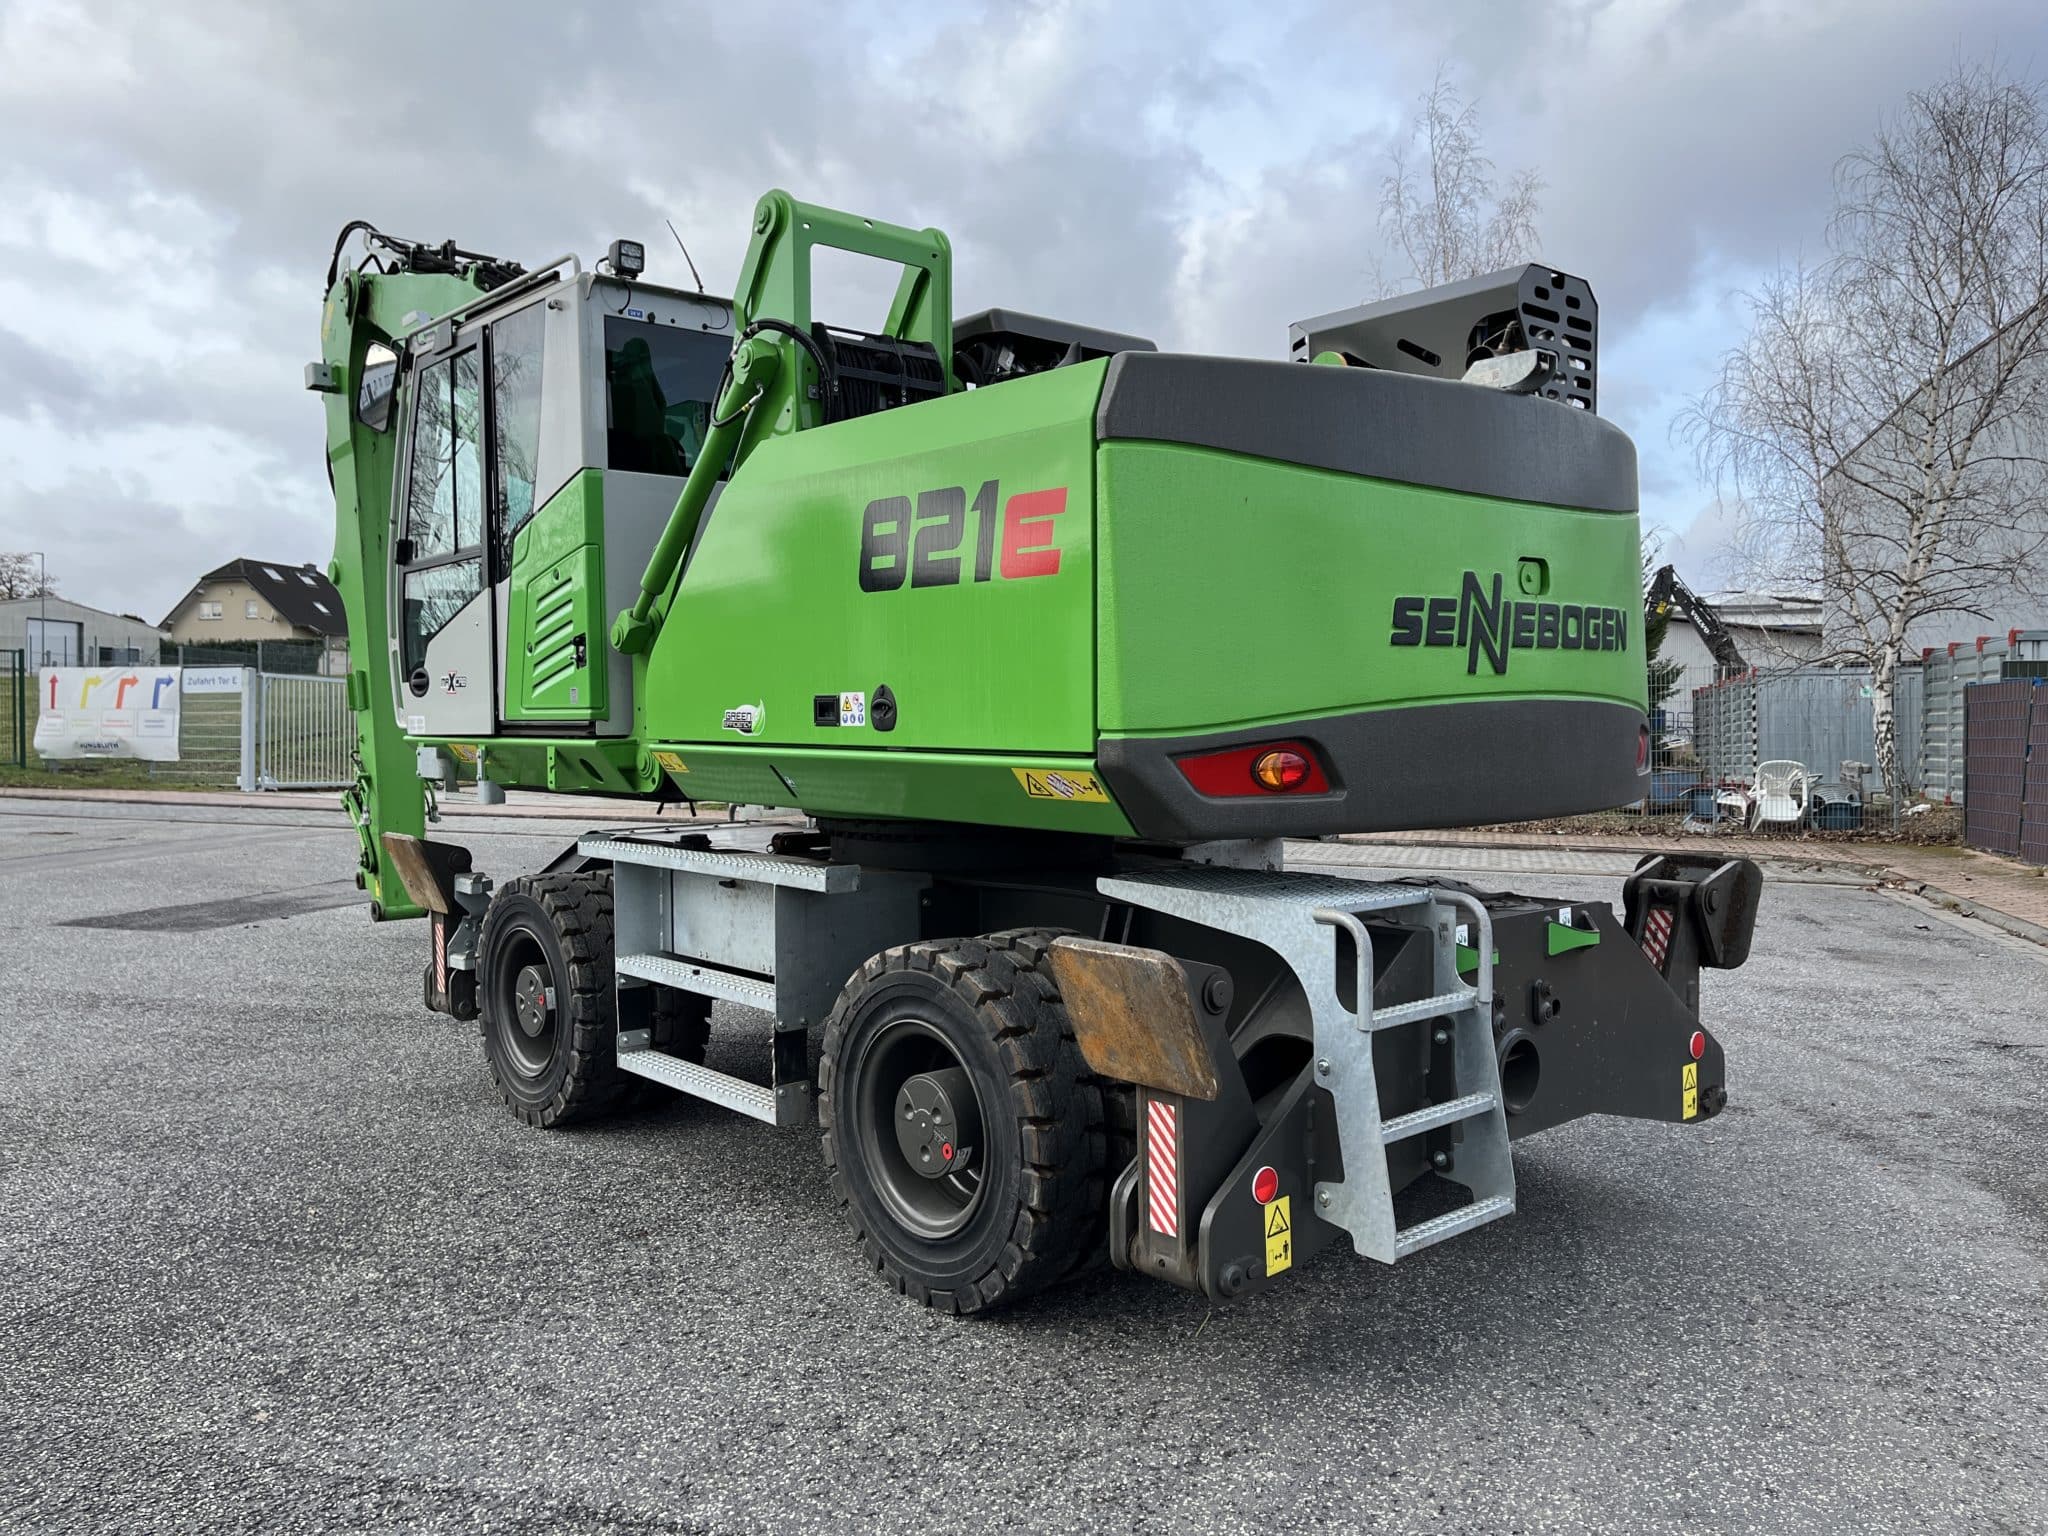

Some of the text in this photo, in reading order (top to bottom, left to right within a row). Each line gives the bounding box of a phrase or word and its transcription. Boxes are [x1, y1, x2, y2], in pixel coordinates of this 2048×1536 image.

[858, 479, 1068, 593] 821E
[1391, 570, 1627, 675] SENNEBOGEN
[1691, 609, 1710, 634] VOLVO
[187, 676, 239, 686] Zufahrt Tor E
[725, 711, 752, 721] GREEN
